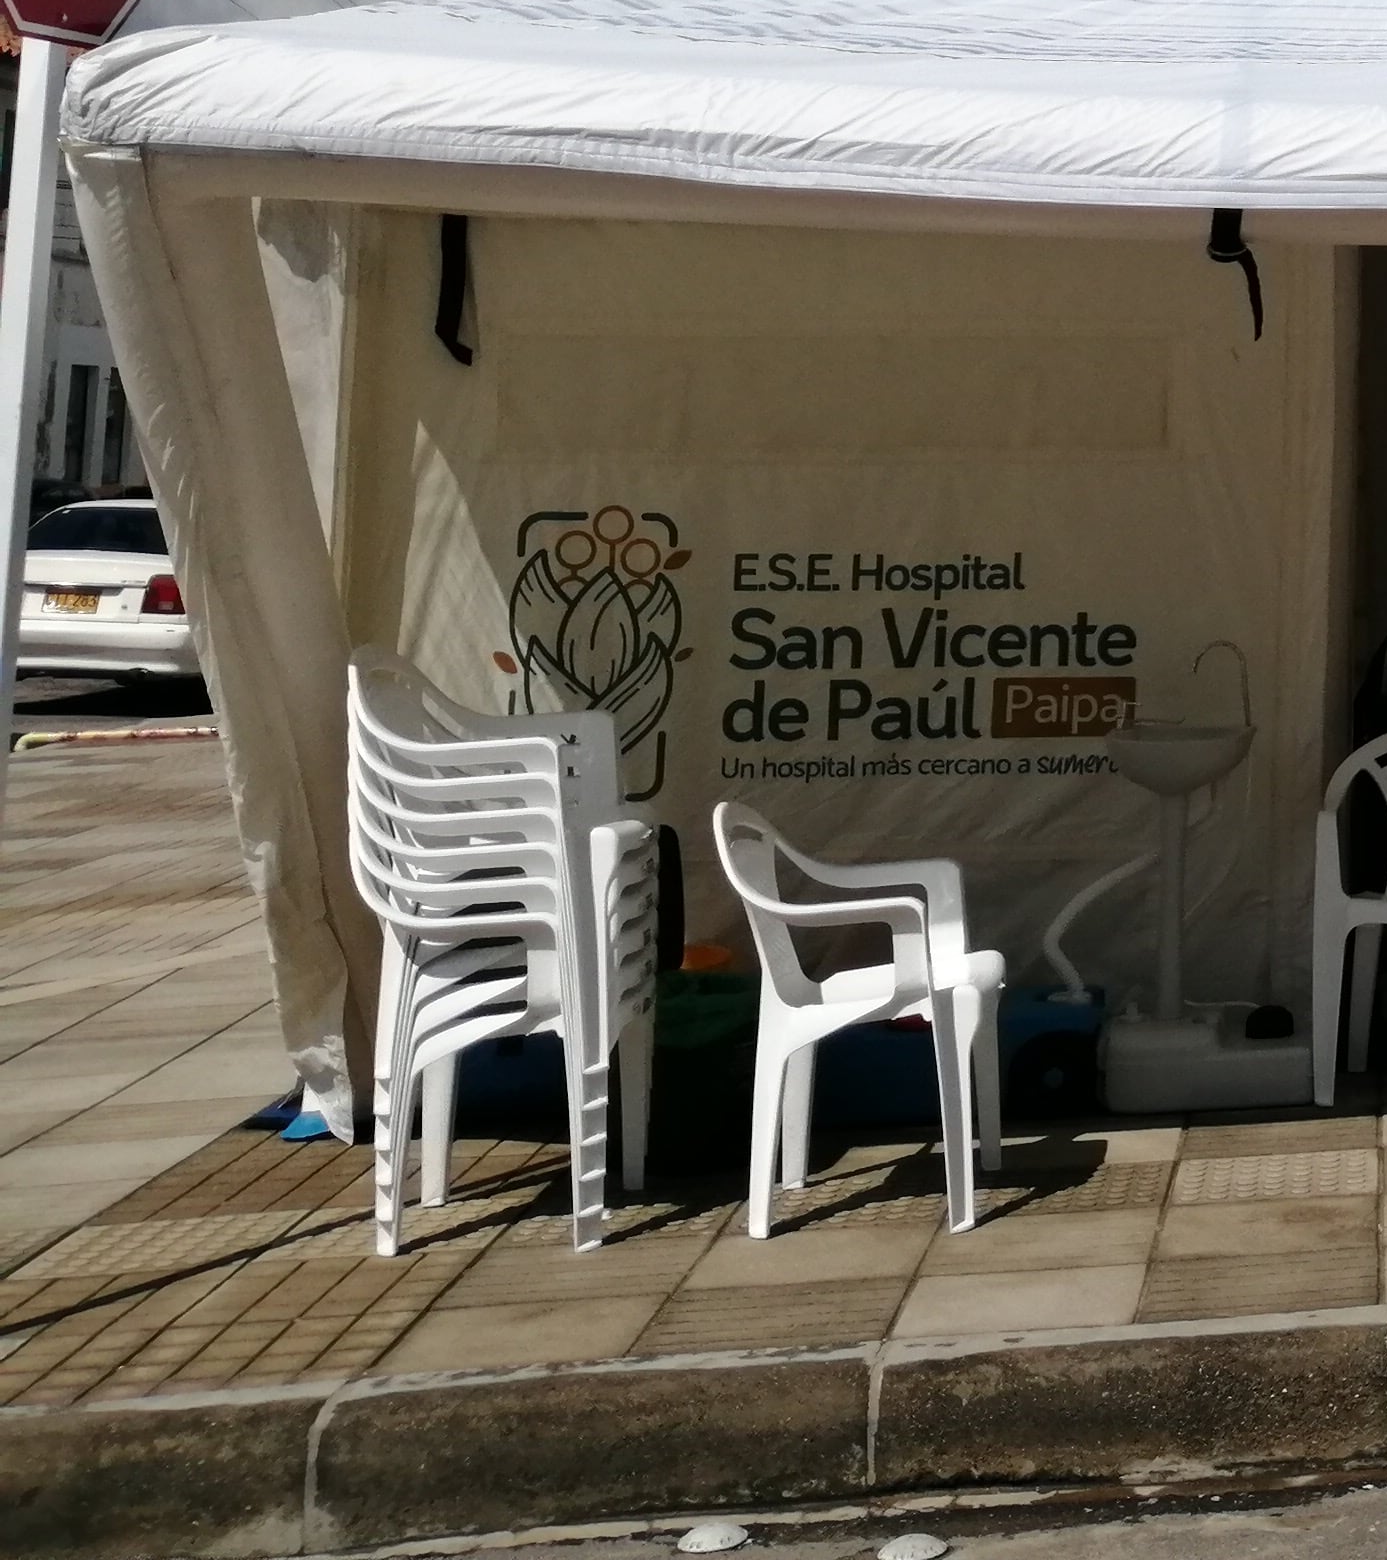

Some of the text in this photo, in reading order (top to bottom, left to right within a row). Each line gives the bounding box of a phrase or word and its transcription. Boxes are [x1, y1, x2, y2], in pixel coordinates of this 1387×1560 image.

[733, 551, 1025, 601] E.S.E. Hospital
[728, 607, 1137, 670] San Vicente
[722, 676, 983, 743] de Paúl
[1004, 683, 1123, 733] Paipa
[721, 757, 755, 780] Un
[761, 754, 856, 783] hospital
[862, 752, 912, 778] más
[917, 758, 1012, 776] cercano
[1017, 758, 1031, 774] a
